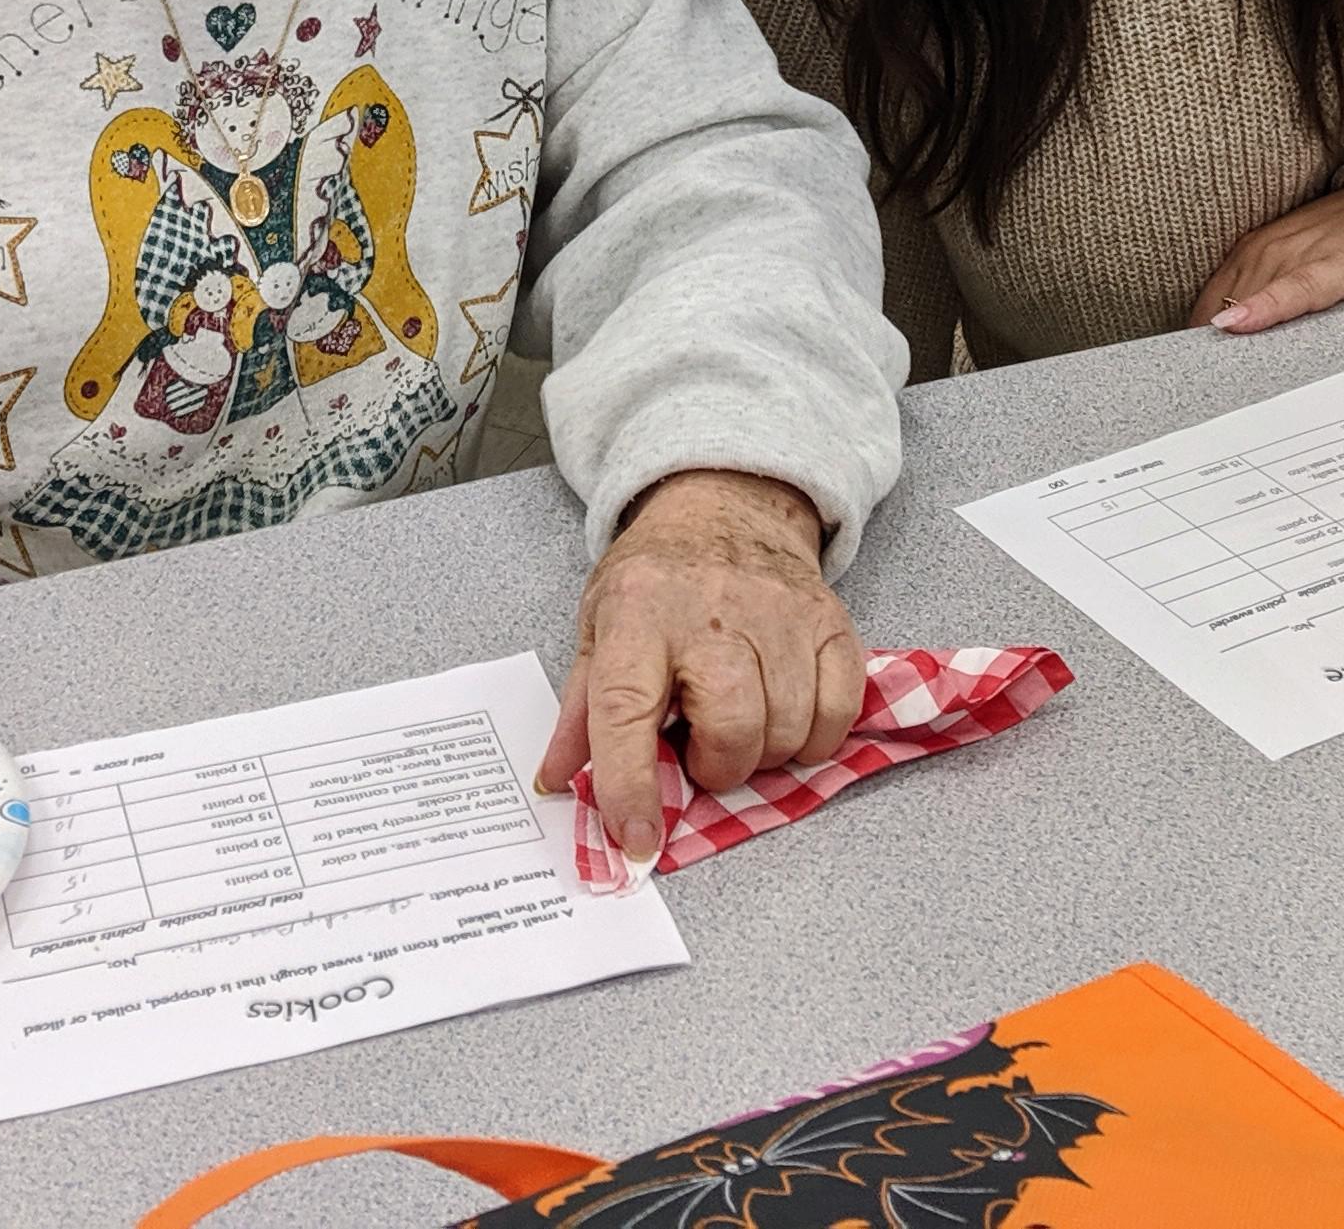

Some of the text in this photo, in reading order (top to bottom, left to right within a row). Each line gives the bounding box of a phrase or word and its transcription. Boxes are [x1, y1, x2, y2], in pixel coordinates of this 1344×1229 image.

[92, 751, 165, 772] total score
[194, 716, 485, 780] Presentation 15 points
[201, 746, 498, 811] Pleasing flavor, no off-flavor 30 points
[358, 735, 492, 767] from any ingredient
[210, 764, 506, 829] Even texture and consistency 15 points
[215, 795, 520, 856] Evenly and correctly baked for 20 points
[417, 780, 515, 808] type of cookie
[224, 818, 532, 886] Uniform shape, size, and color 20 points
[29, 891, 304, 958] total points possible points awarded
[106, 868, 557, 969] Name of Product: No:
[456, 895, 568, 928] and then baked
[22, 907, 574, 1038] A small cake made from stiff, sweet dough that is dropped, rolled, or sliced
[246, 975, 395, 1023] Cookies
